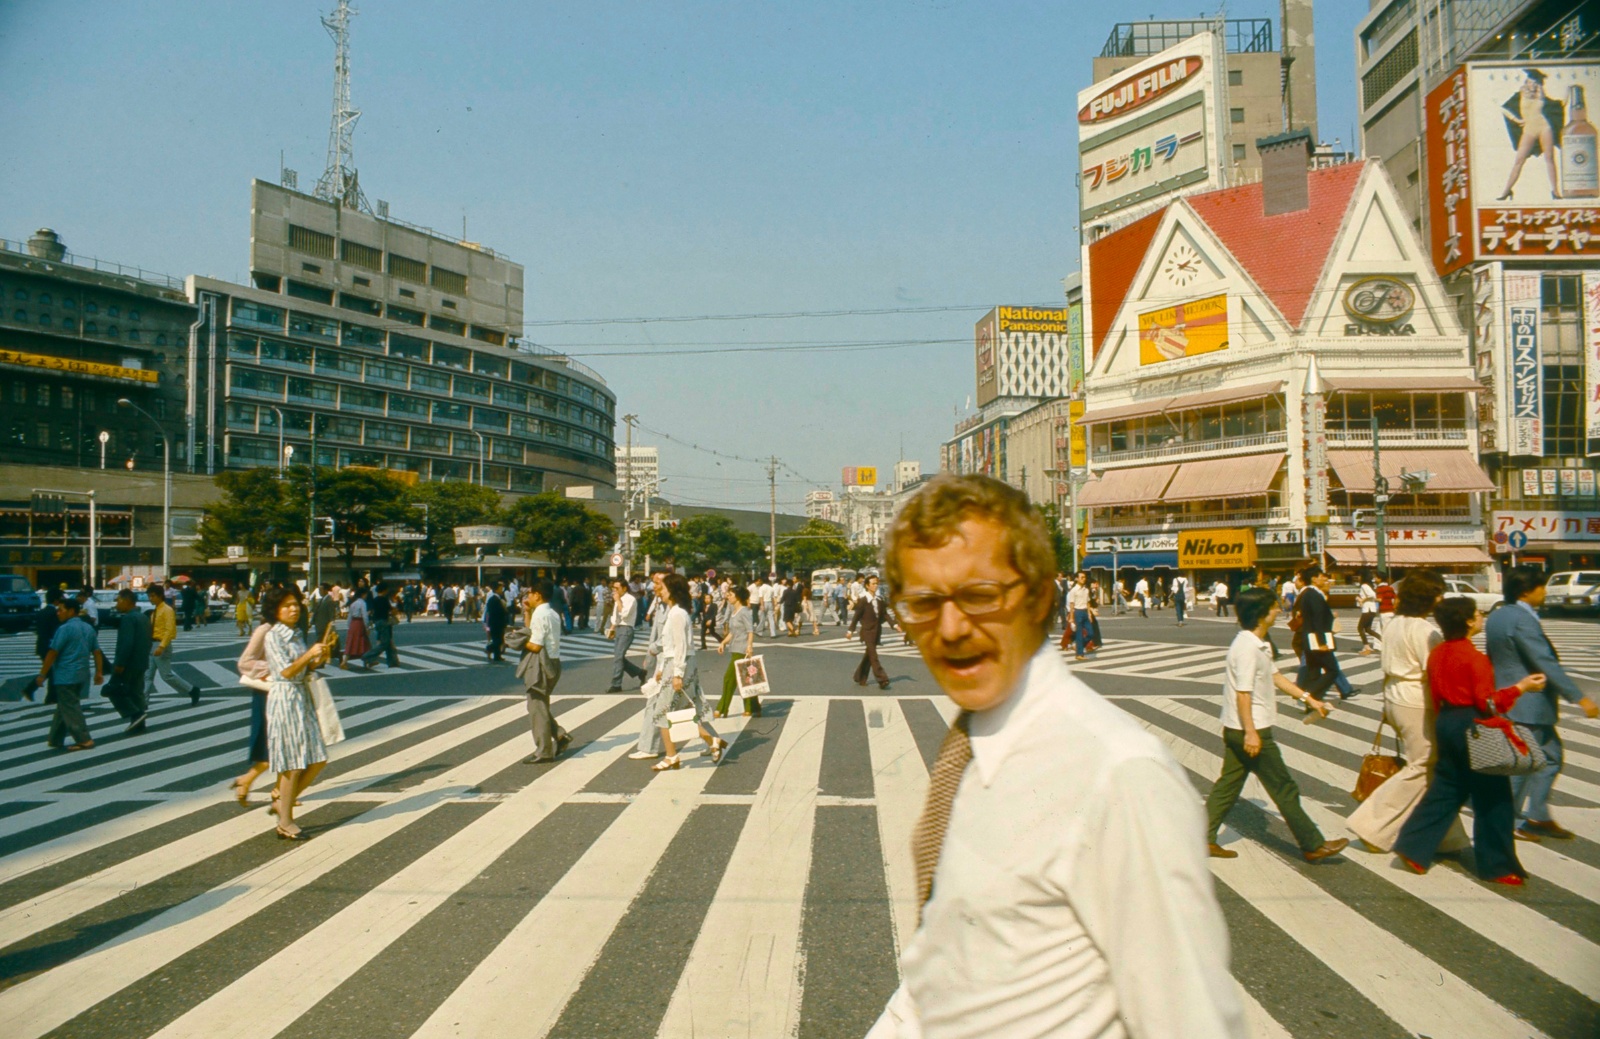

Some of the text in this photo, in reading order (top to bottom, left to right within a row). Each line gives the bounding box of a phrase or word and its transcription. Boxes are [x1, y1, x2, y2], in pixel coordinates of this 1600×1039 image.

[1090, 58, 1187, 120] FUJI FILM
[1083, 130, 1204, 188] フジカラー
[1000, 307, 1067, 321] National
[1000, 320, 1067, 333] Panasonic
[1512, 307, 1539, 418] 雨のロスアンゼルス
[1345, 530, 1428, 541] 不二洋菓子
[1182, 538, 1245, 556] Nikon
